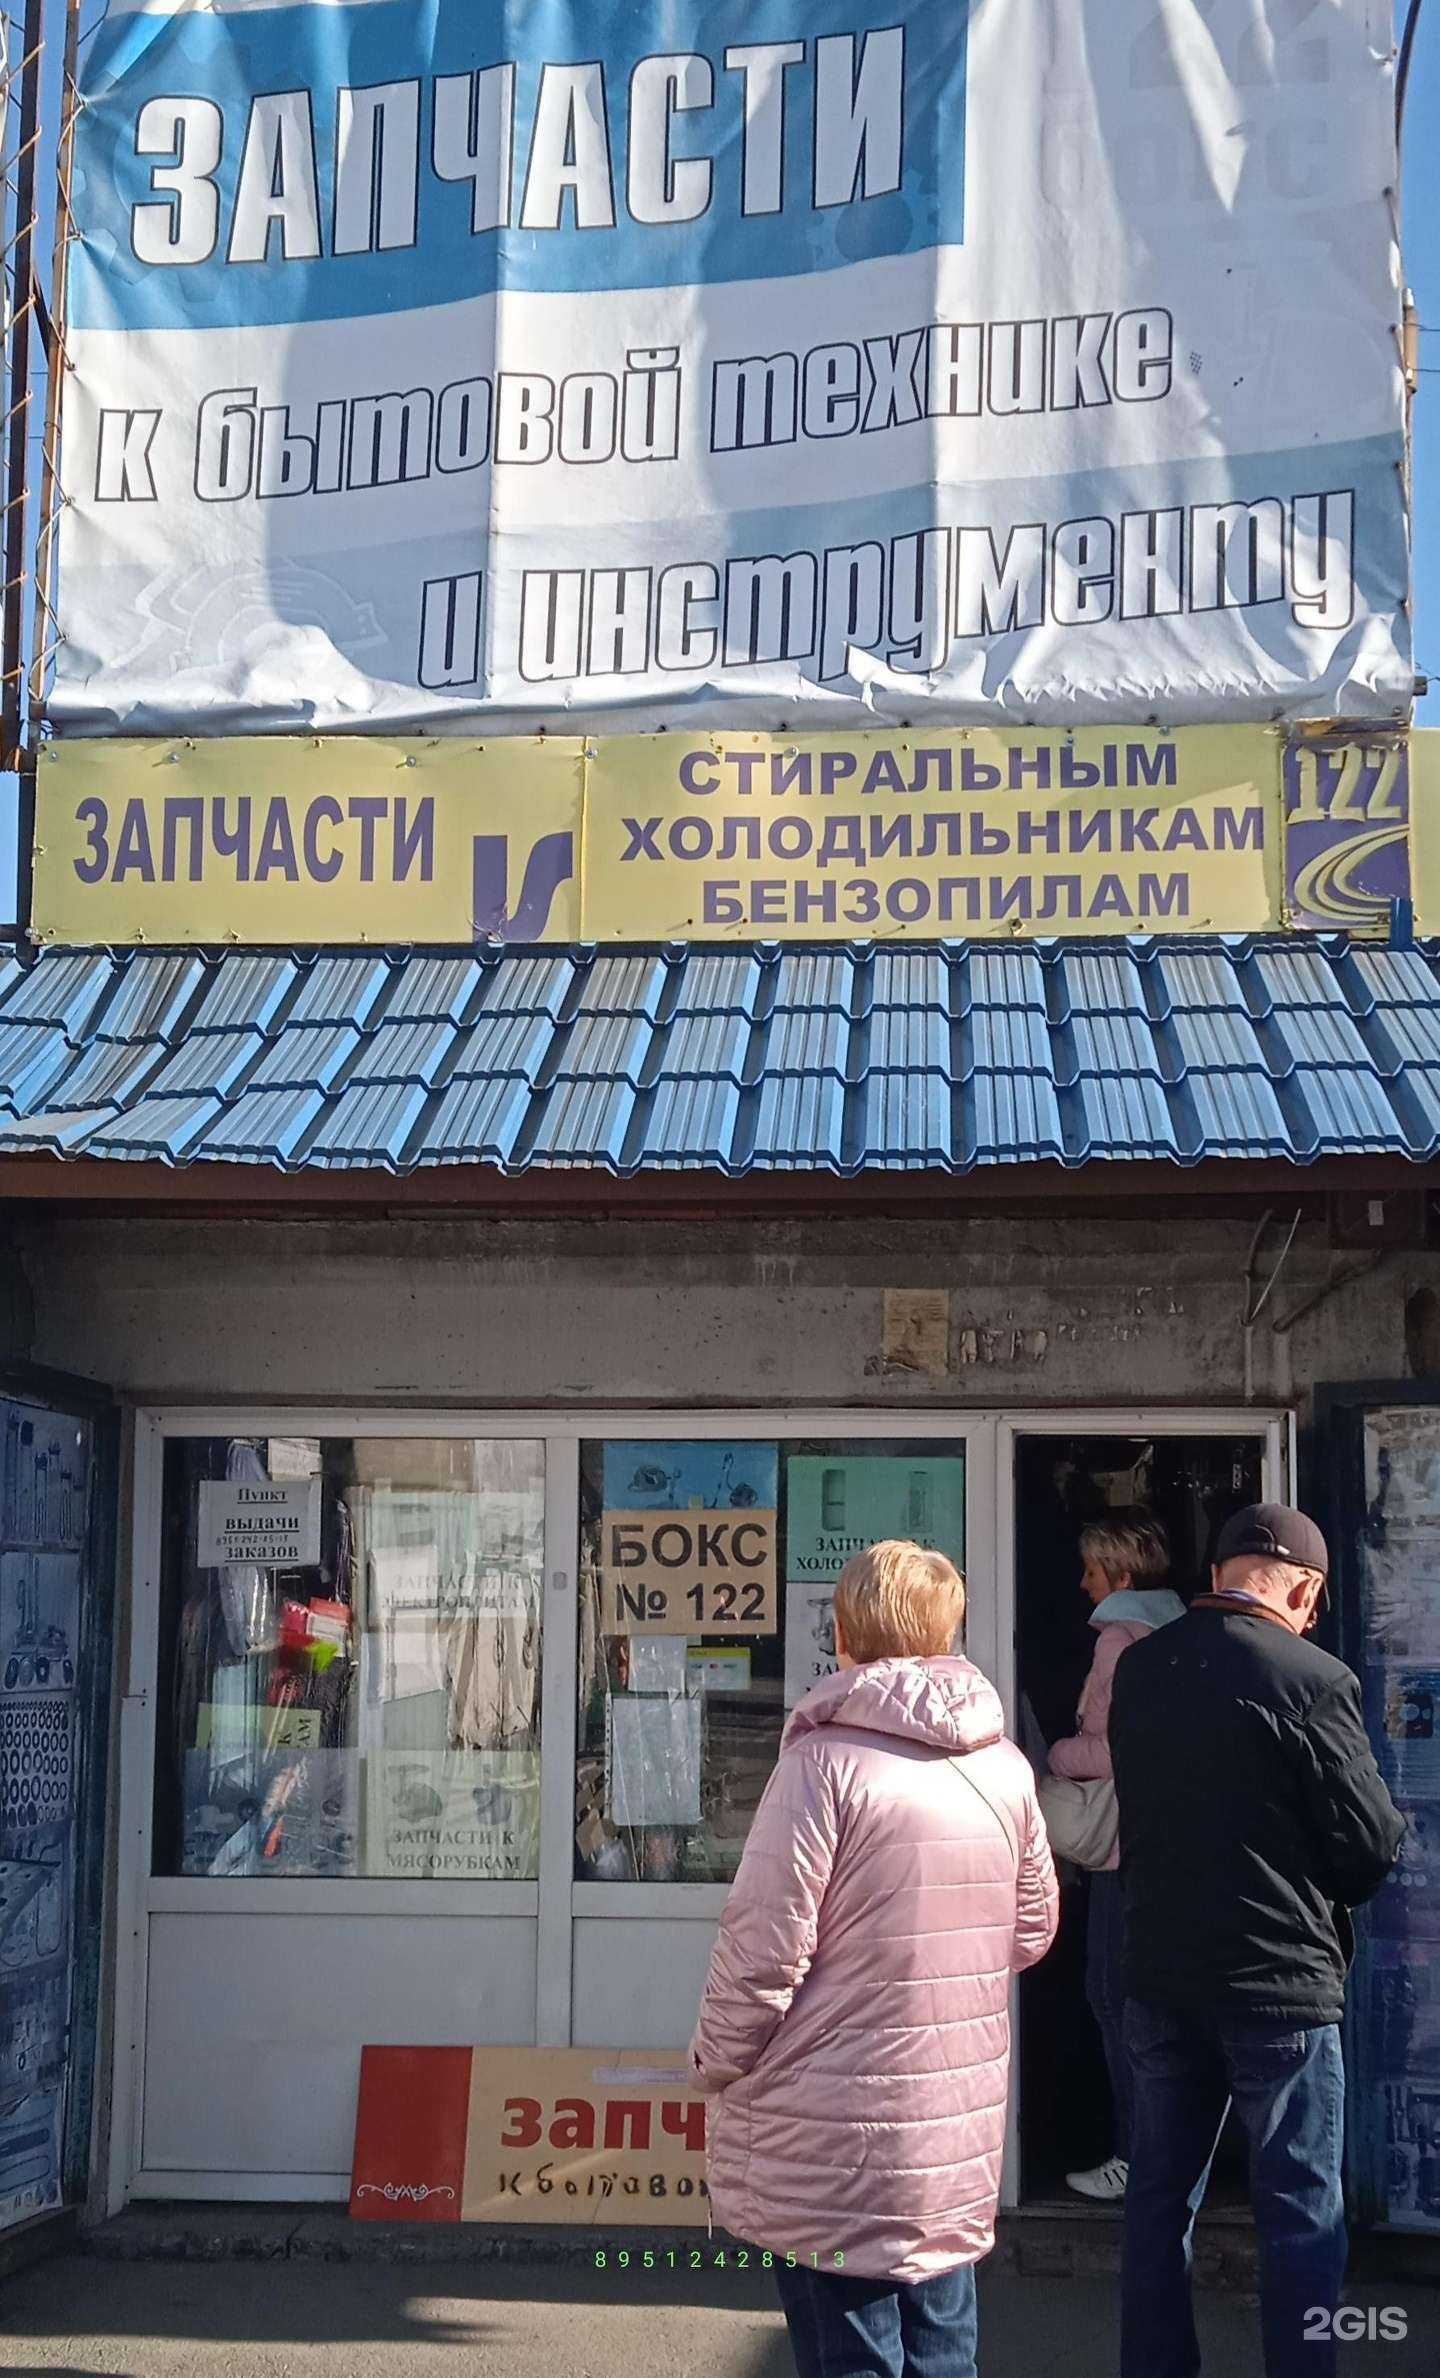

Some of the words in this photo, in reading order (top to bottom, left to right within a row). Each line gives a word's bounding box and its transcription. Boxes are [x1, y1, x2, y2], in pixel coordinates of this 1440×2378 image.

[130, 25, 906, 267] ЗАПЧАСТИ
[195, 346, 684, 502] бытовой
[709, 307, 1174, 455] технике
[417, 568, 484, 689] и
[521, 489, 1357, 684] инструменту
[679, 744, 1178, 796] СТИРАЛЬНЫМ
[1287, 742, 1402, 824] 122
[73, 796, 435, 883] ЗАПЧАСТИ
[619, 806, 1265, 868] ХОЛОДИЛЬНИКАМ
[702, 873, 1190, 924] БЕНЗОПИЛАМ
[237, 1488, 288, 1502] Пункт
[225, 1517, 299, 1531] выдачи
[610, 1523, 768, 1568] БОКС
[225, 1545, 299, 1559] заказов
[616, 1584, 667, 1621] №
[686, 1583, 766, 1621] 122
[387, 1854, 521, 1871] МЯСОРУБКАМ
[394, 1829, 492, 1845] ЗАПЧАСТИ
